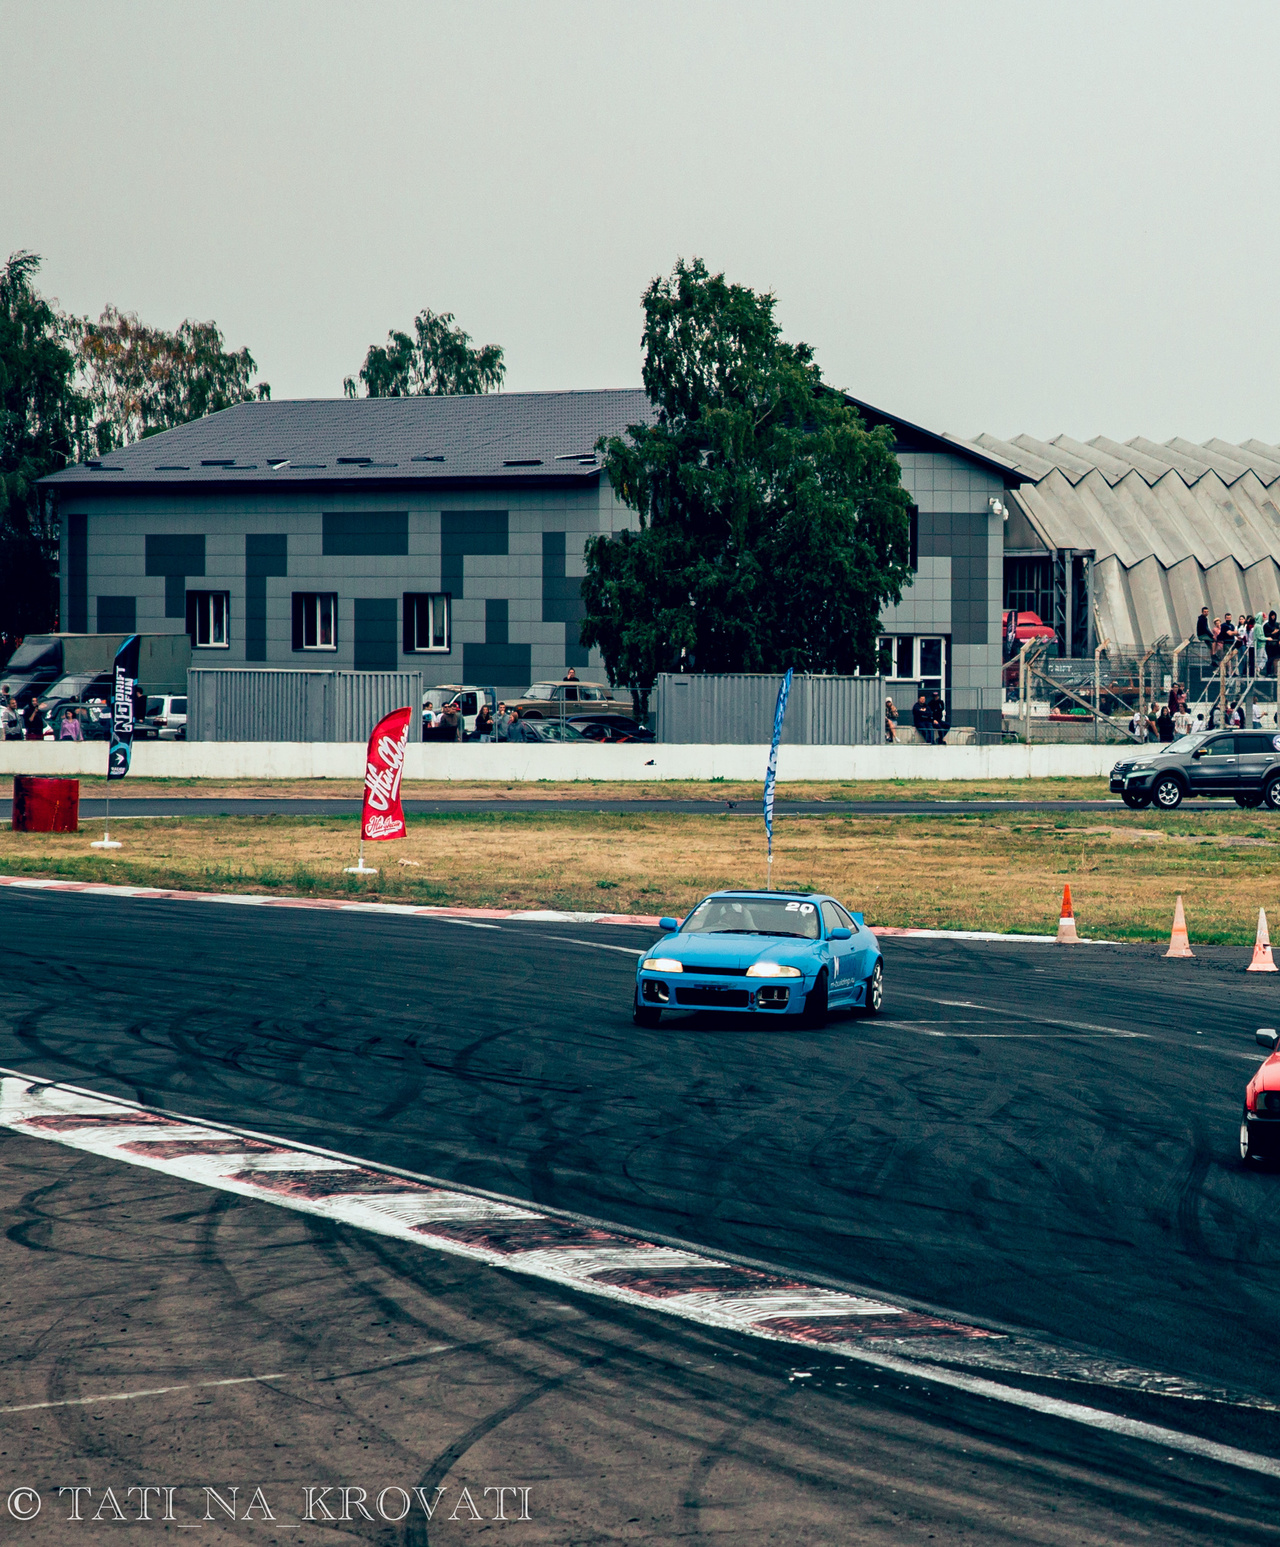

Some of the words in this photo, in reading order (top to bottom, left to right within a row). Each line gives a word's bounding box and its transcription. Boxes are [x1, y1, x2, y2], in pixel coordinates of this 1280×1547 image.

[115, 665, 126, 702] DRIFT
[124, 678, 134, 703] FUN
[785, 901, 815, 914] 20
